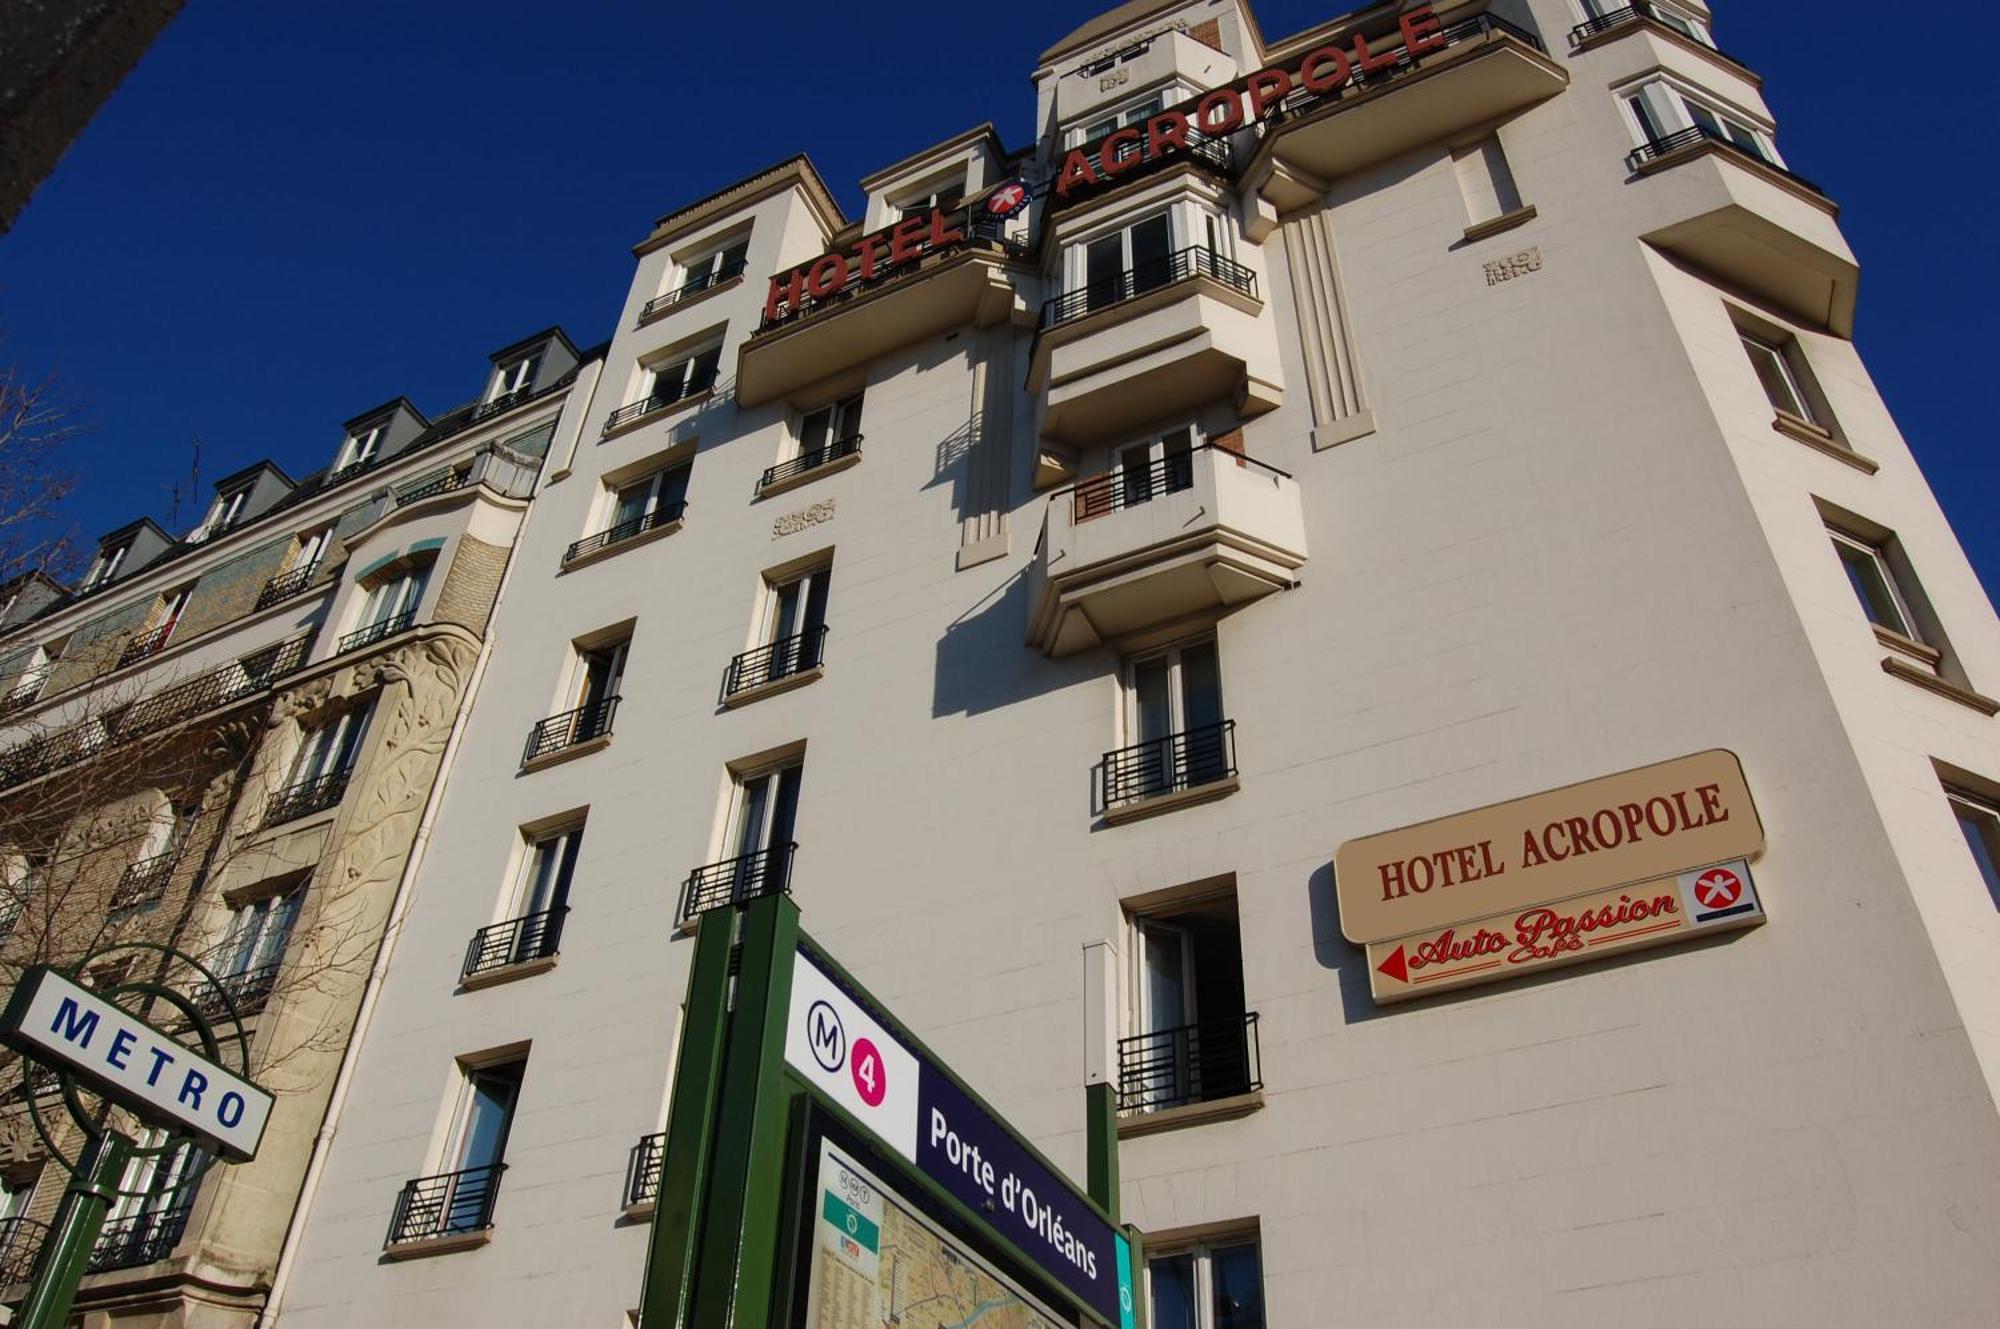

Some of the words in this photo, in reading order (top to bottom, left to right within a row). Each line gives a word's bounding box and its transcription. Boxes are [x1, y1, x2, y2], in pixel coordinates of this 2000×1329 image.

[766, 208, 964, 321] HOTEL
[1056, 6, 1448, 197] ACROPOLE
[1378, 840, 1505, 901] HOTEL
[1521, 783, 1729, 869] ACROPOLE
[1408, 928, 1512, 970] Auto
[1514, 894, 1679, 946] Passion
[50, 997, 245, 1129] METRO
[816, 1012, 838, 1060] M
[859, 1054, 876, 1093] 4
[931, 1106, 995, 1195] Porte
[1001, 1174, 1098, 1281] d'Orléans
